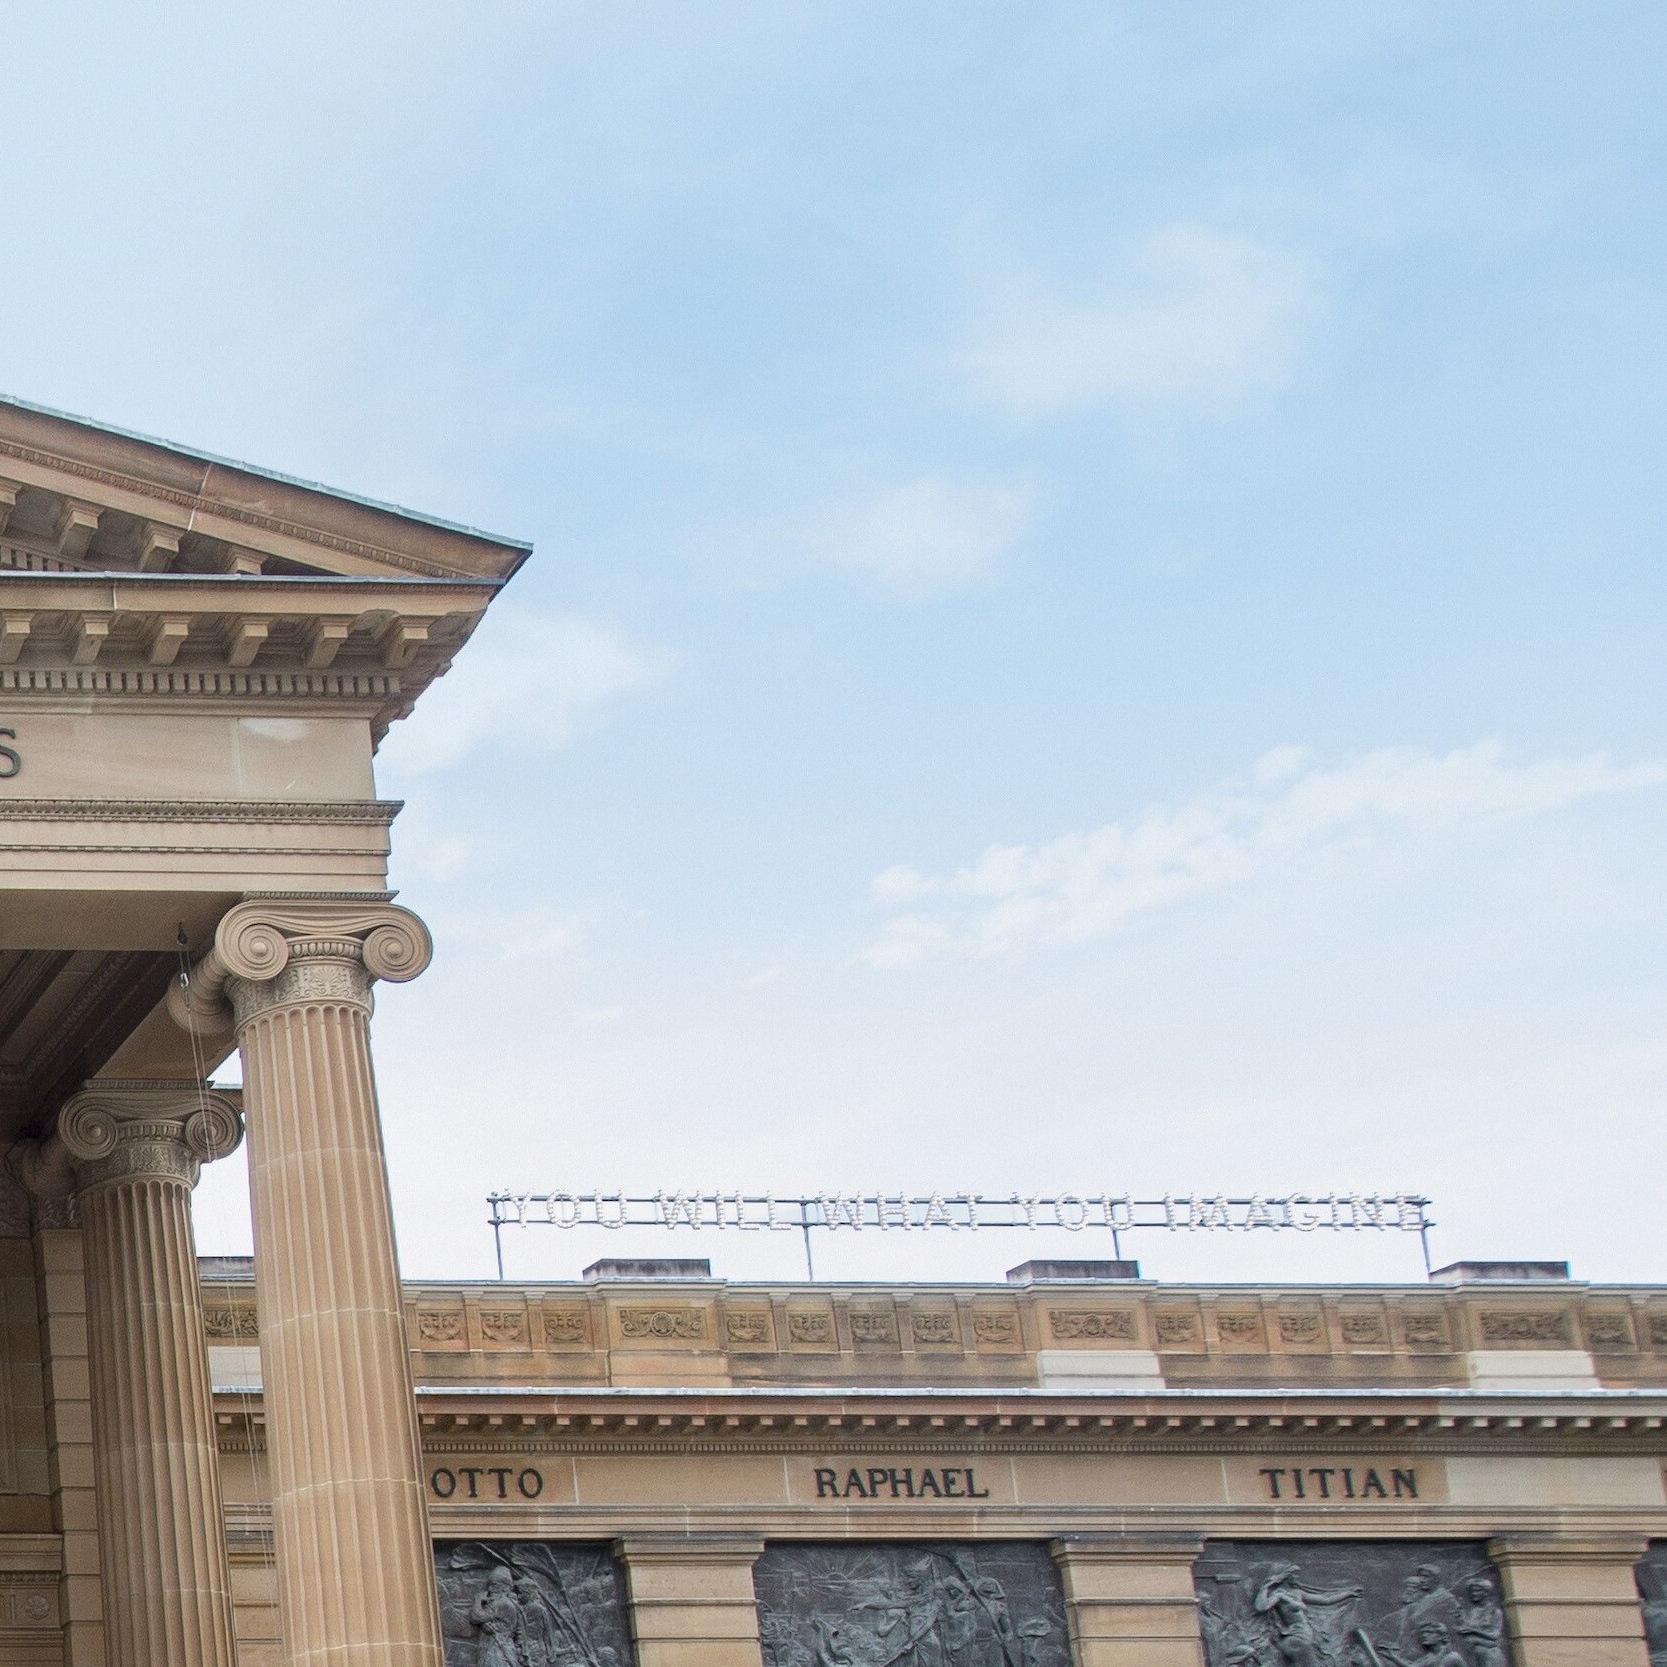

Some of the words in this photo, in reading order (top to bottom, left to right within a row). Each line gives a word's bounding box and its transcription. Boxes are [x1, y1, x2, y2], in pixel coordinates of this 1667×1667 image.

[503, 1190, 627, 1229] YOU
[655, 1190, 791, 1231] WILL
[814, 1190, 981, 1232] WHAT
[1011, 1191, 1134, 1232] YOU
[1163, 1191, 1427, 1232] IMAGINE
[430, 1468, 544, 1499] OTTO
[814, 1467, 990, 1499] RAPHAEL
[1259, 1467, 1419, 1499] TITIAN
